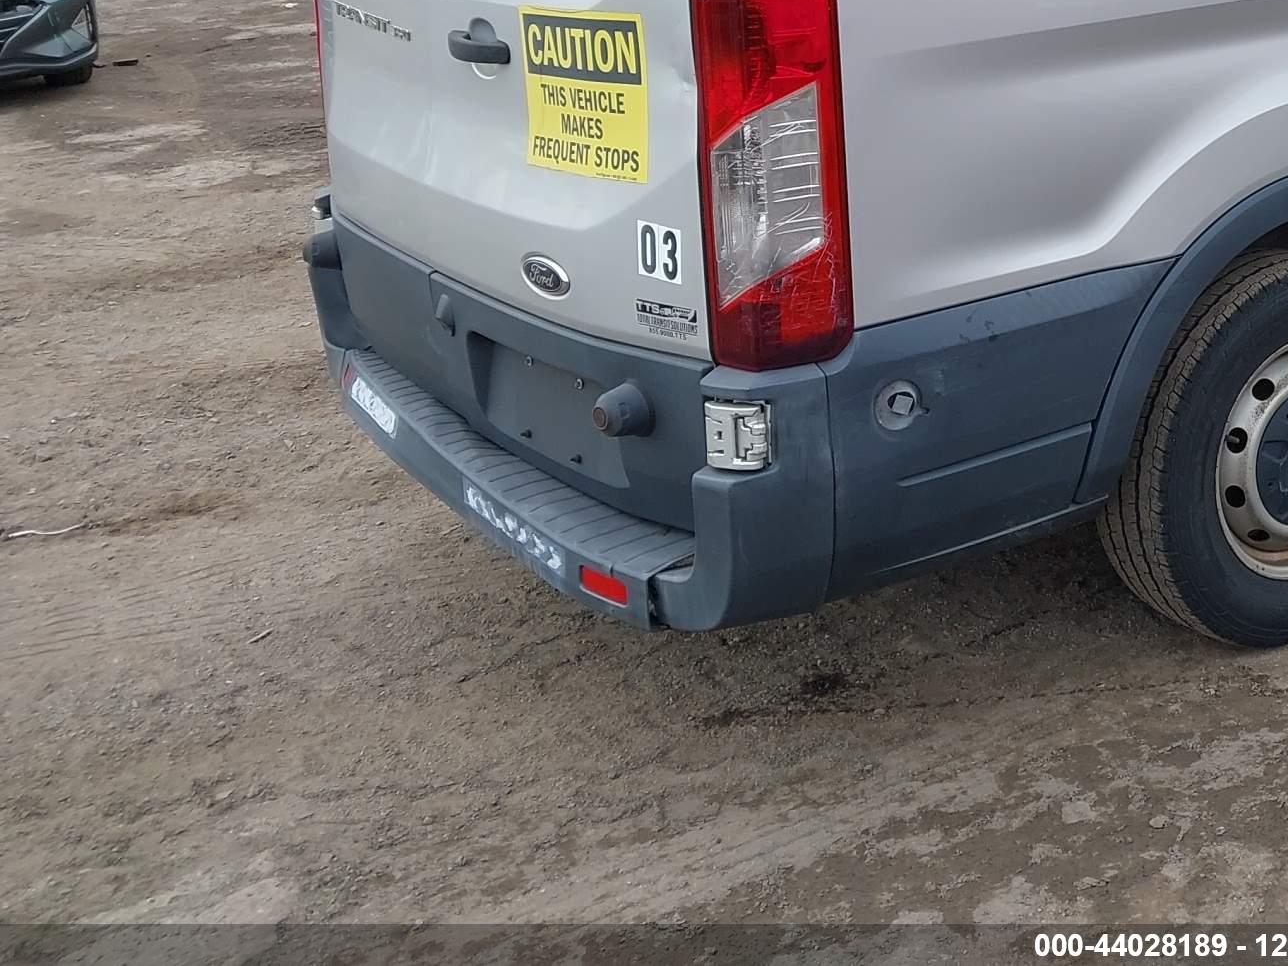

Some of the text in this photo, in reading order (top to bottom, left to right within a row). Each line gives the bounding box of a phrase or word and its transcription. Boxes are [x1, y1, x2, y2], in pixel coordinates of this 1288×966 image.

[527, 23, 637, 74] CAUTION
[540, 83, 625, 114] THIS VEHICLE
[561, 113, 604, 139] MAKES
[533, 135, 640, 173] FREQUENT STOPS
[640, 224, 678, 281] 03
[529, 263, 554, 288] Ford
[635, 300, 660, 314] TTS
